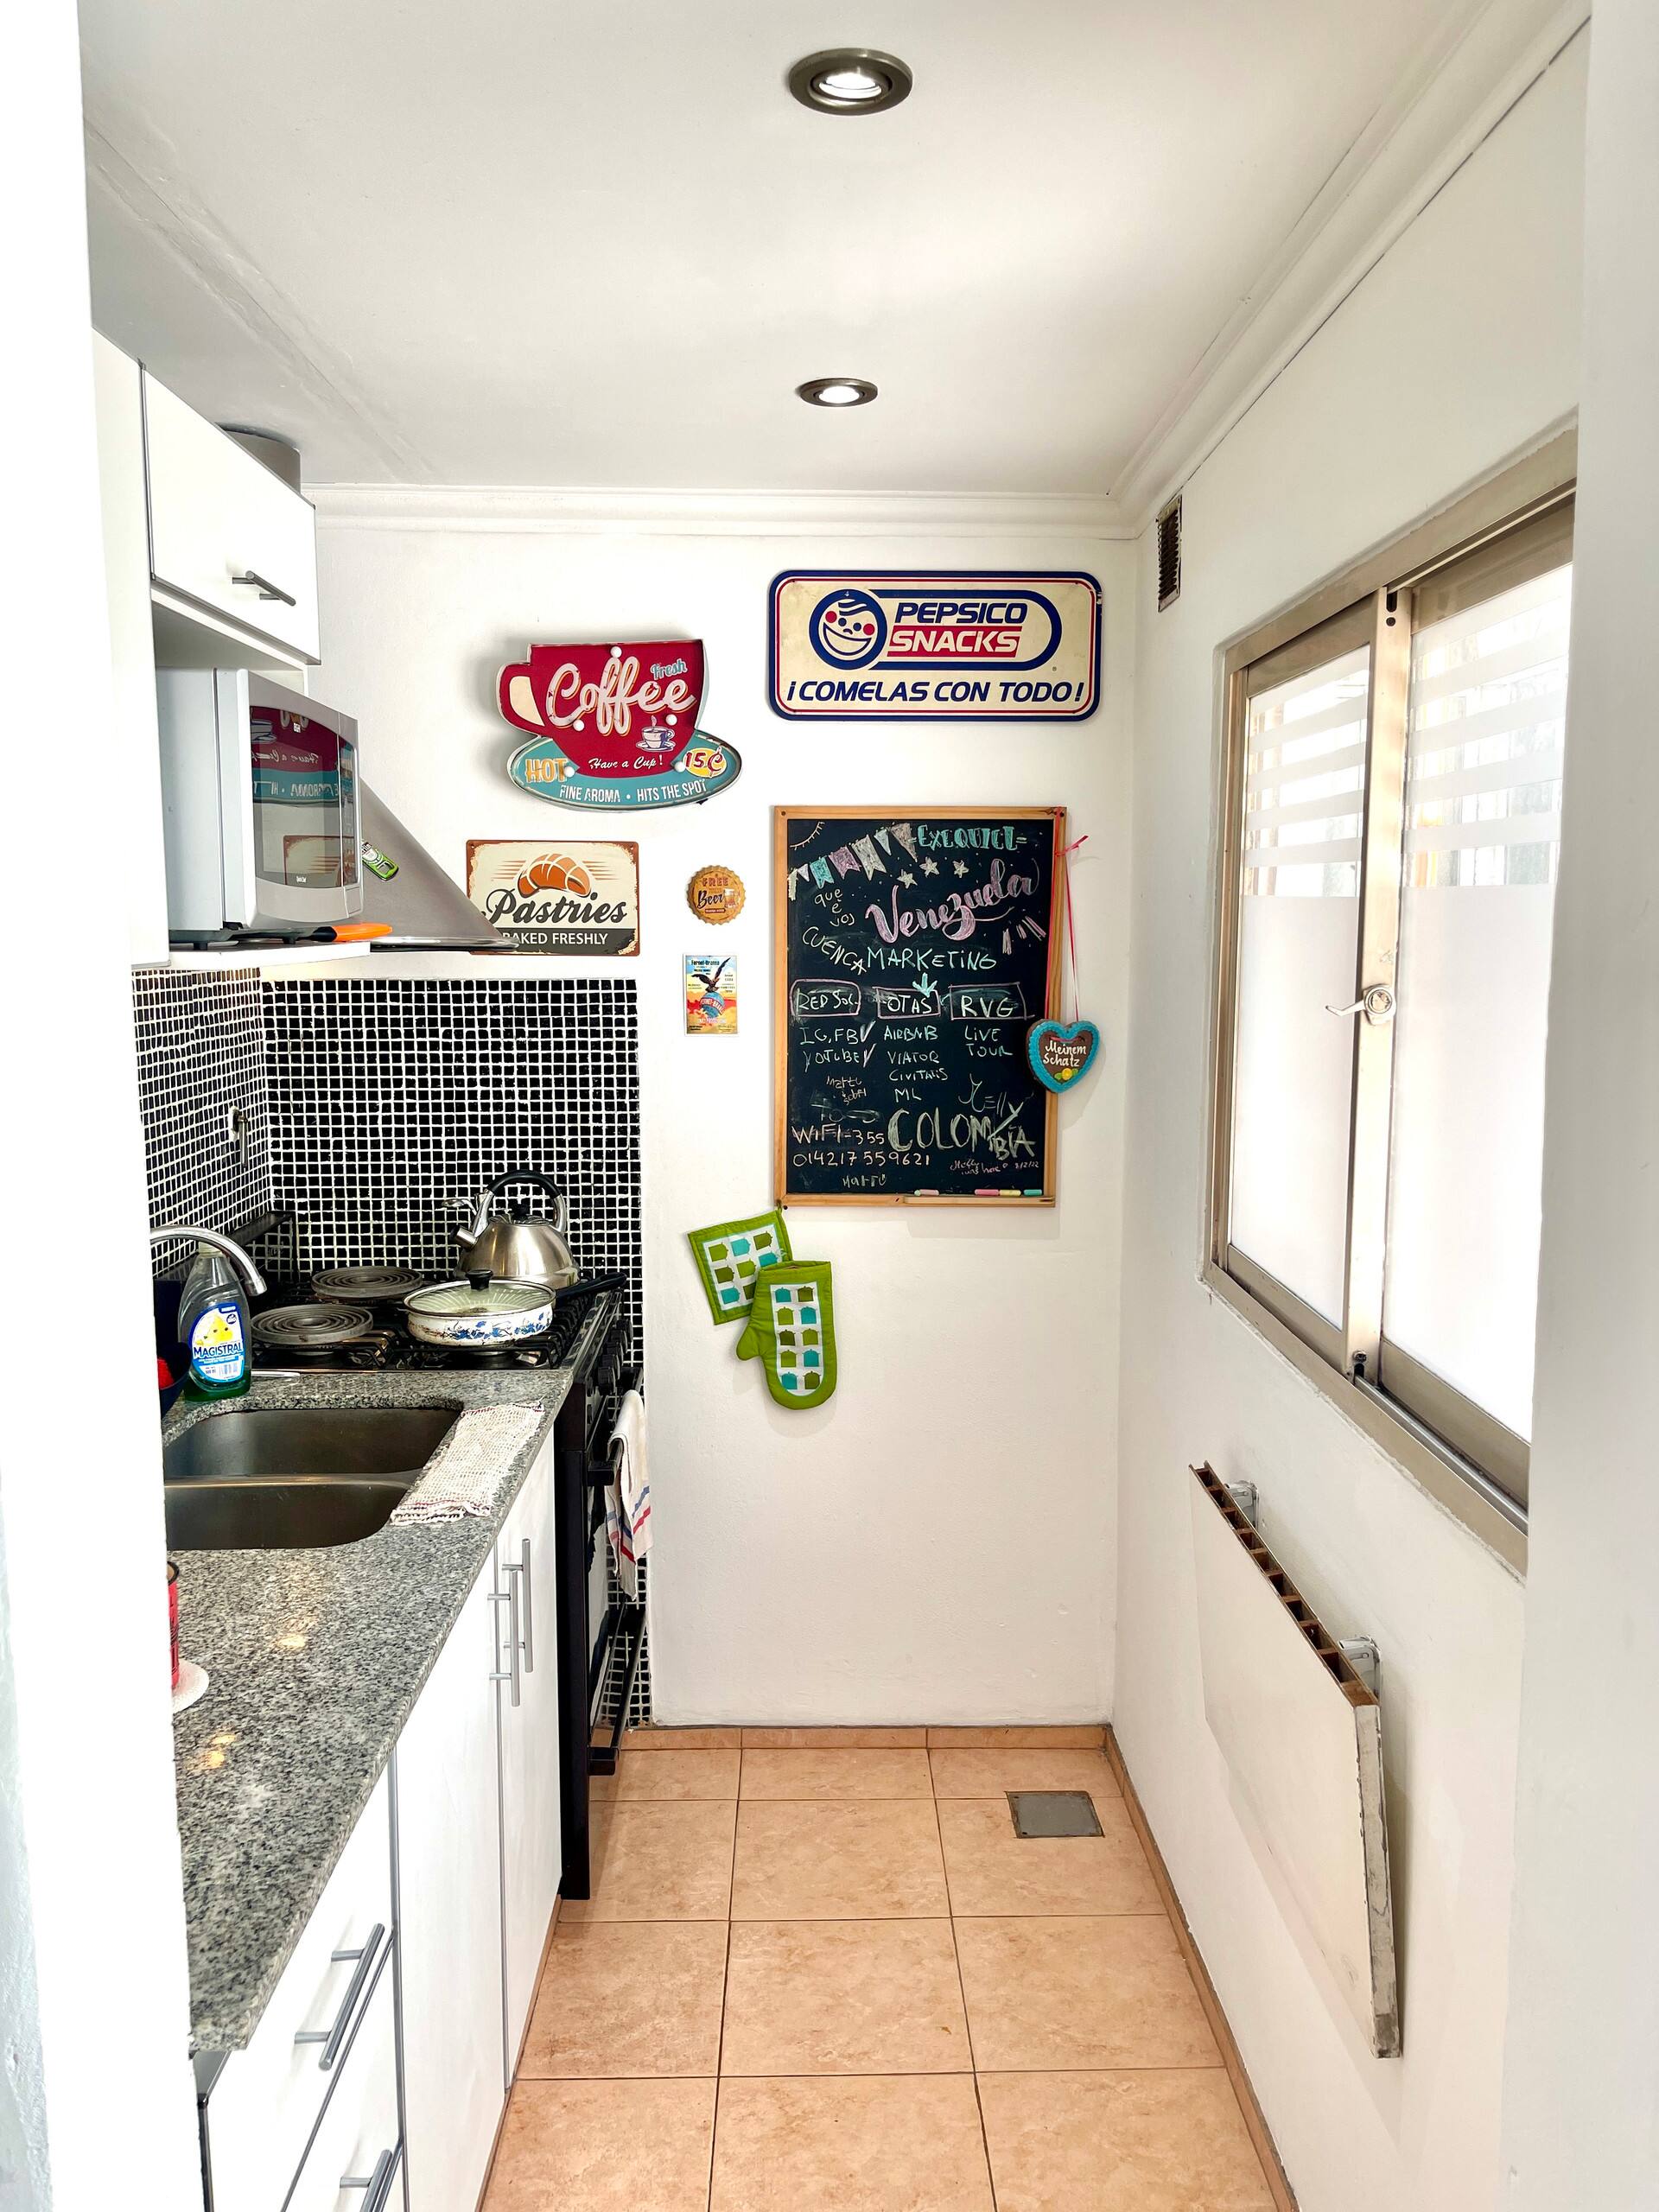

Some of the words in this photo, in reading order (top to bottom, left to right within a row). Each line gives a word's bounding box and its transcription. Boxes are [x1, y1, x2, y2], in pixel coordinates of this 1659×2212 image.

[895, 602, 1027, 624] PEPSICO
[887, 630, 1020, 652] SNACKS
[546, 656, 696, 736] Coffee
[935, 682, 992, 702] CON
[999, 682, 1084, 702] TODO!
[525, 759, 567, 783] HOT
[588, 758, 618, 769] Have
[560, 785, 582, 801] FINE
[584, 787, 620, 803] AROMA
[637, 787, 659, 803] HITS
[661, 785, 681, 801] THE
[682, 779, 707, 798] SPOT
[702, 877, 728, 887] FREE
[481, 888, 627, 925] Pastries
[697, 890, 723, 909] Beer
[865, 858, 1039, 944] Venezuela
[552, 932, 607, 945] FRESHLY
[803, 926, 867, 976] CUENCA
[796, 988, 828, 1010] RED
[887, 995, 931, 1014] OTAS
[961, 995, 1014, 1018] RVG
[1045, 1039, 1087, 1055] Meinem
[887, 1050, 940, 1065] VIATOR
[1043, 1052, 1080, 1067] Schatz
[894, 1088, 922, 1103] ML
[194, 1342, 243, 1358] MAGISTRAL
